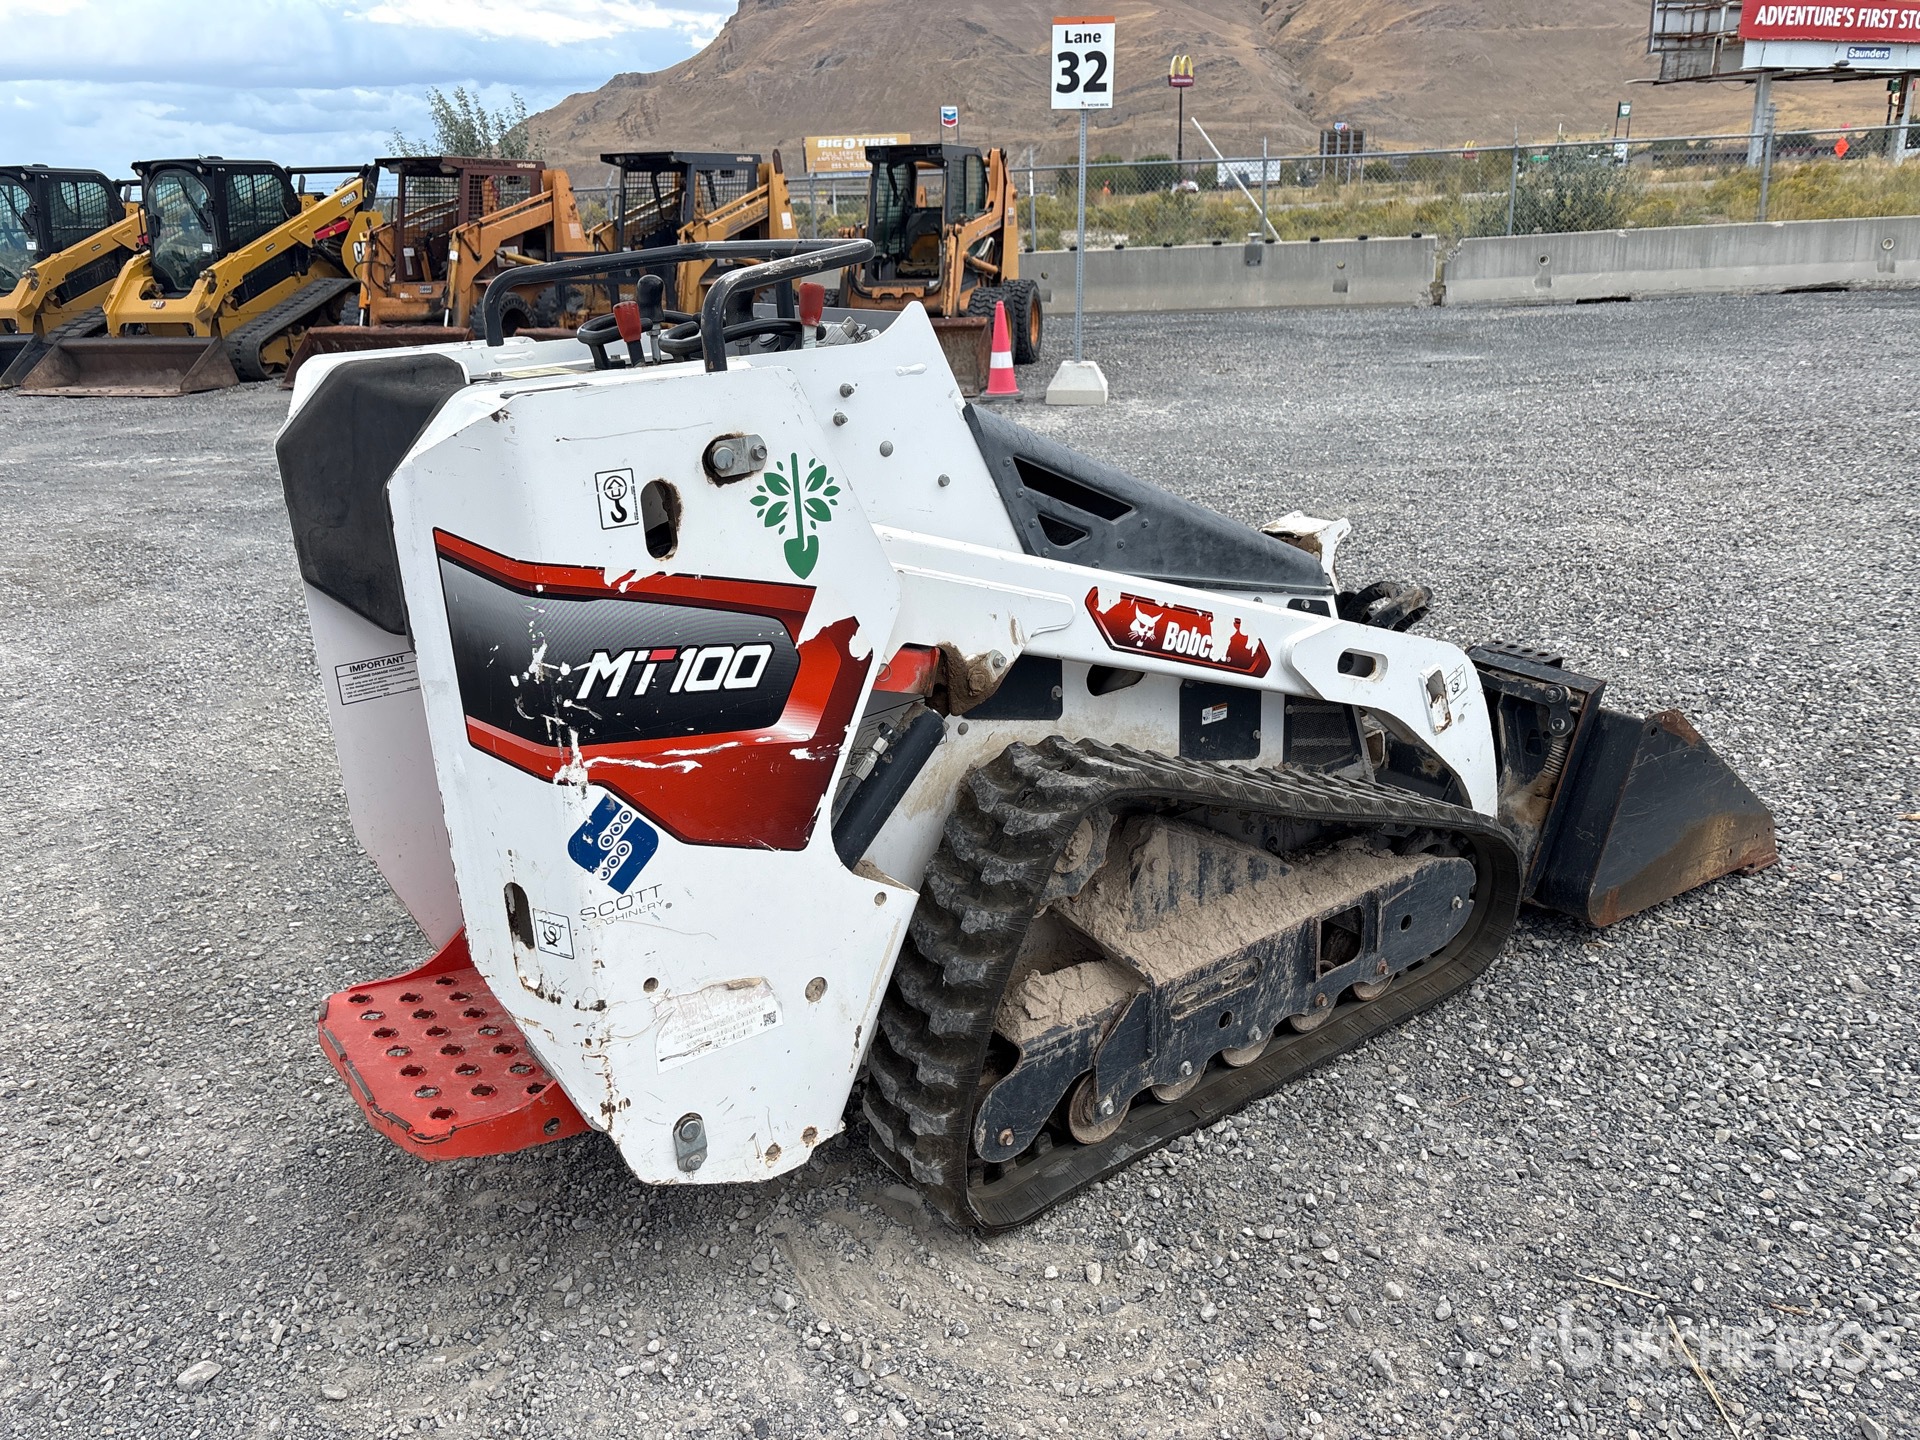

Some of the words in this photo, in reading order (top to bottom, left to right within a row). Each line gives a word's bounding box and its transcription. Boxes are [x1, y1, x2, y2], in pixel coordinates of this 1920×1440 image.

[1754, 5, 1856, 26] ADVENTURE'S
[1856, 8, 1898, 28] FIRST
[1064, 30, 1102, 43] Lane
[1848, 47, 1890, 59] Saunders
[1056, 50, 1107, 94] 32
[817, 139, 843, 148] BIG
[857, 137, 897, 147] TIRES
[742, 203, 763, 223] CASE
[1162, 621, 1226, 662] Bobc
[349, 655, 405, 673] IMPORTANT
[576, 644, 773, 699] MT100
[580, 884, 662, 922] SCOTT
